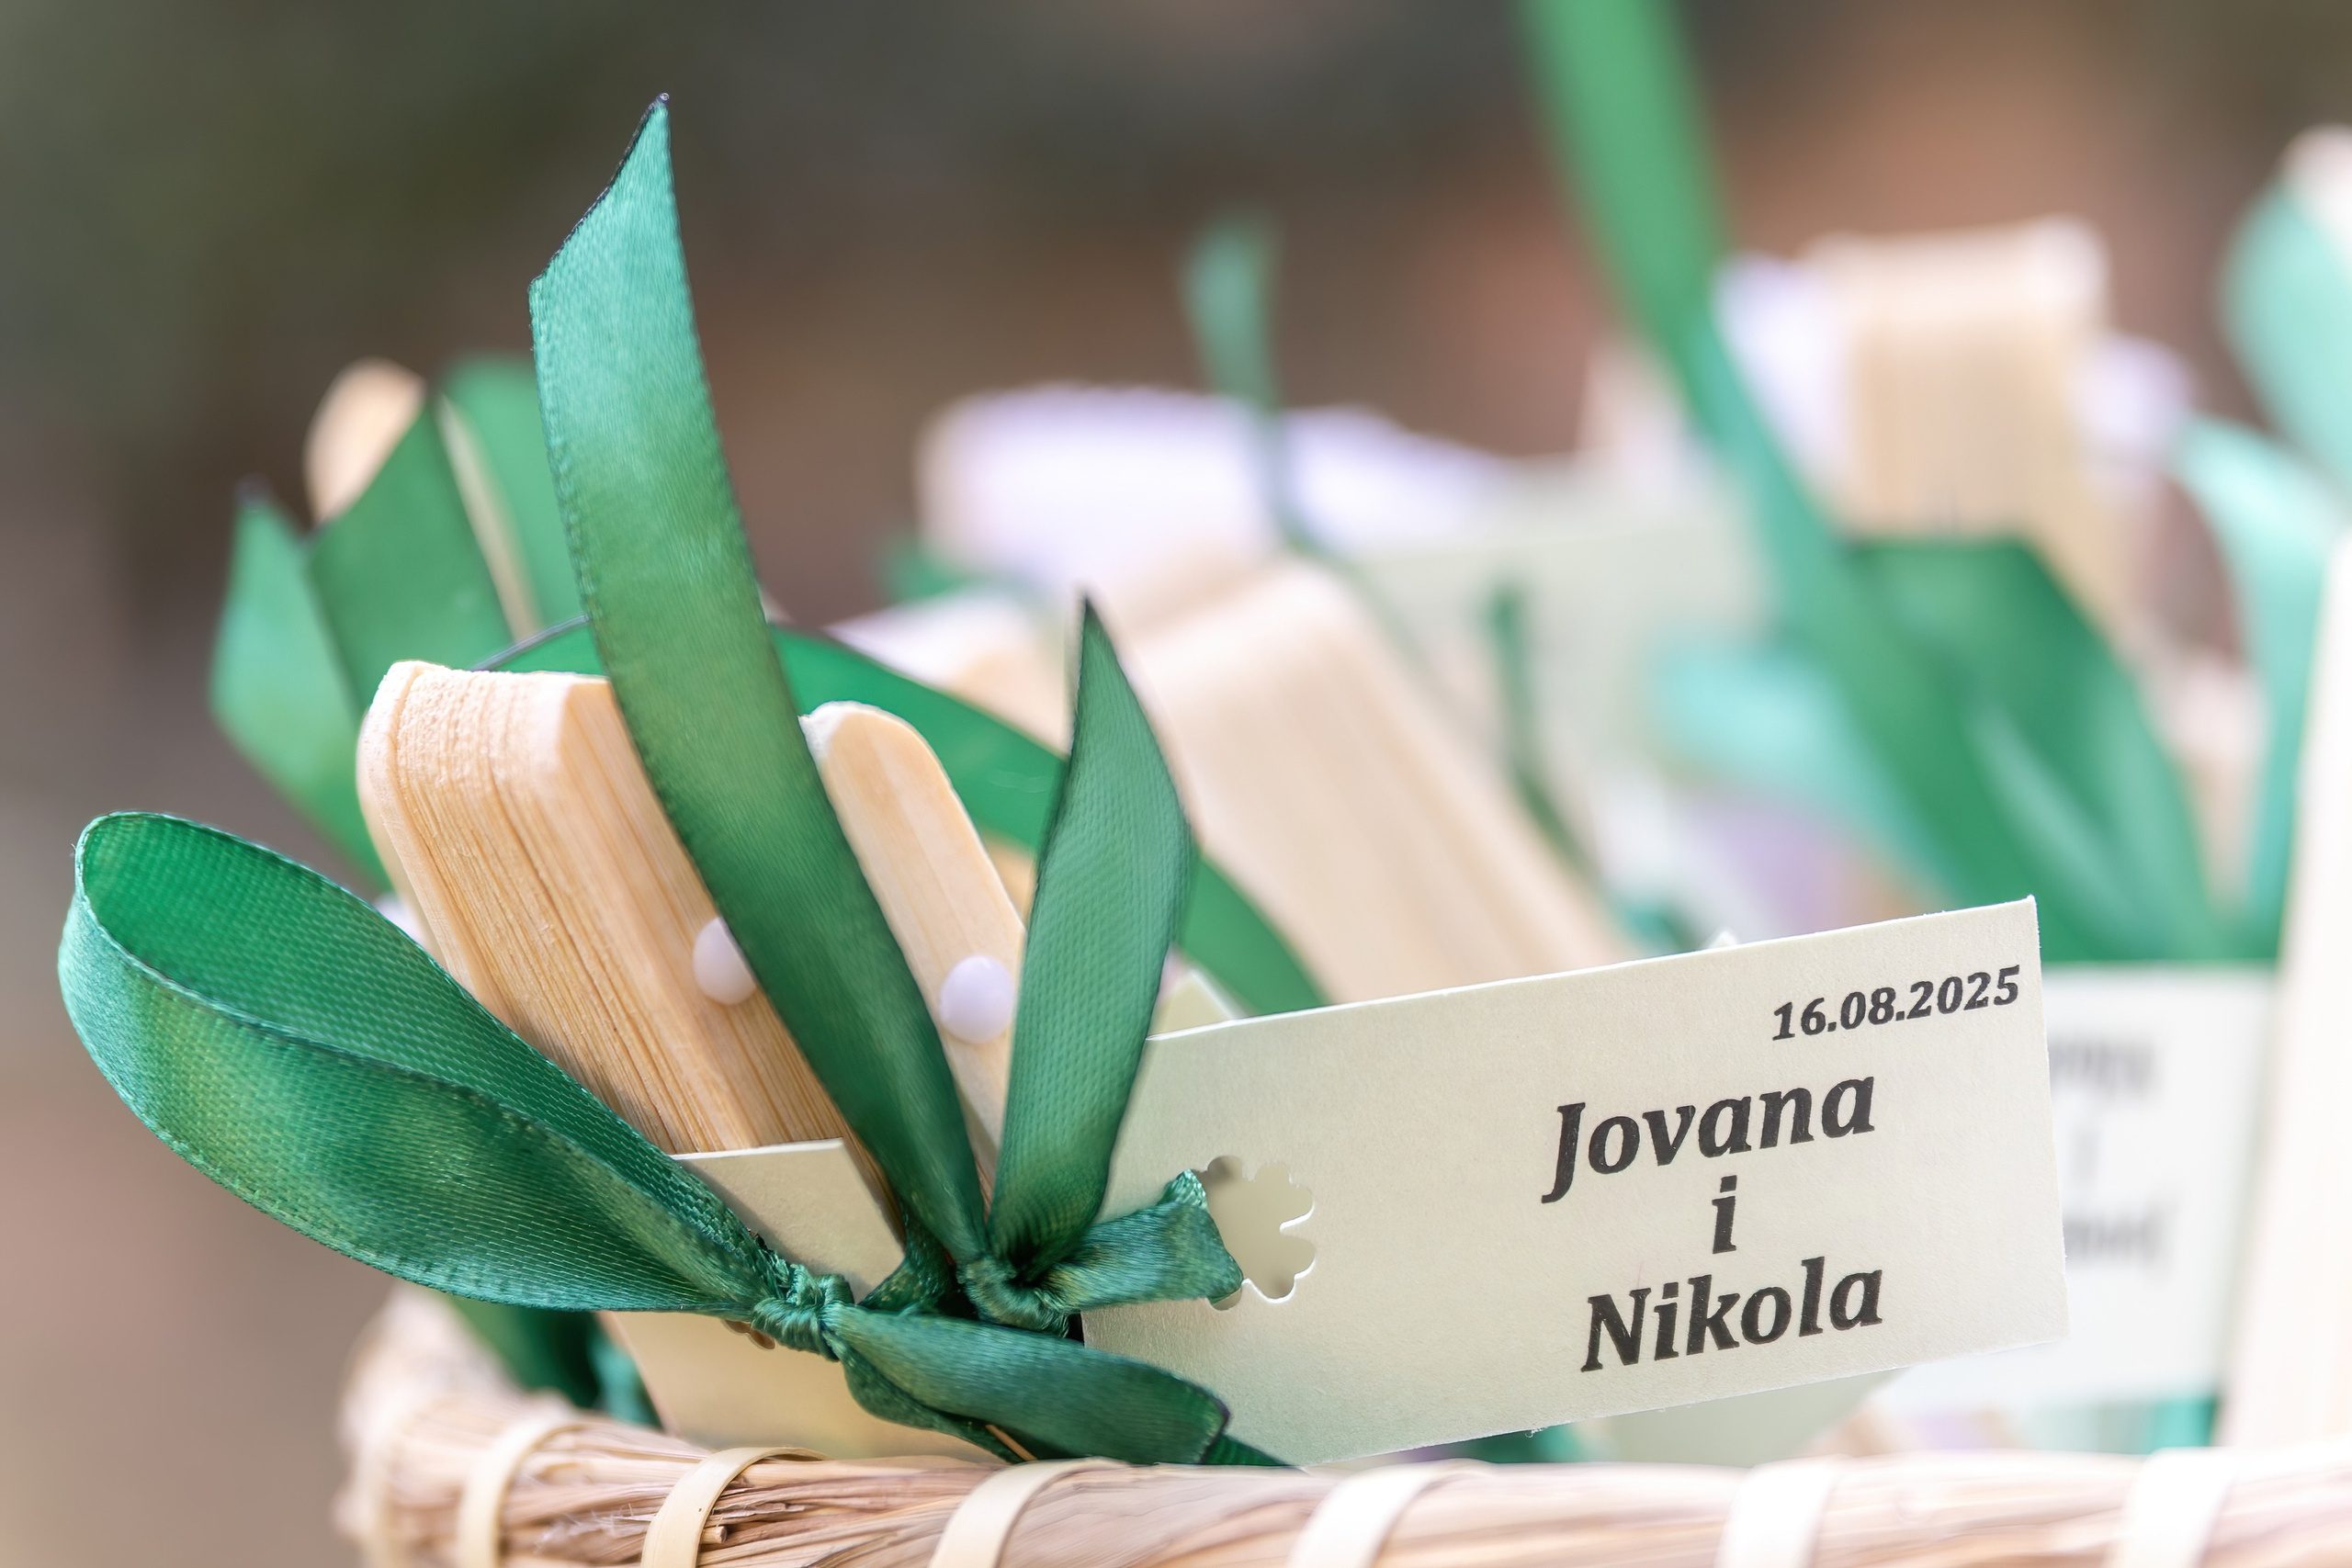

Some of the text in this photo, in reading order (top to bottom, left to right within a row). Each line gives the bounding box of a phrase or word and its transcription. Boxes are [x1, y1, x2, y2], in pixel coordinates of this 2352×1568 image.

[1772, 964, 2020, 1041] 16.08.2025
[1541, 1076, 1875, 1204] Jovana
[1712, 1175, 1737, 1255] i
[1580, 1256, 1883, 1373] Nikola
